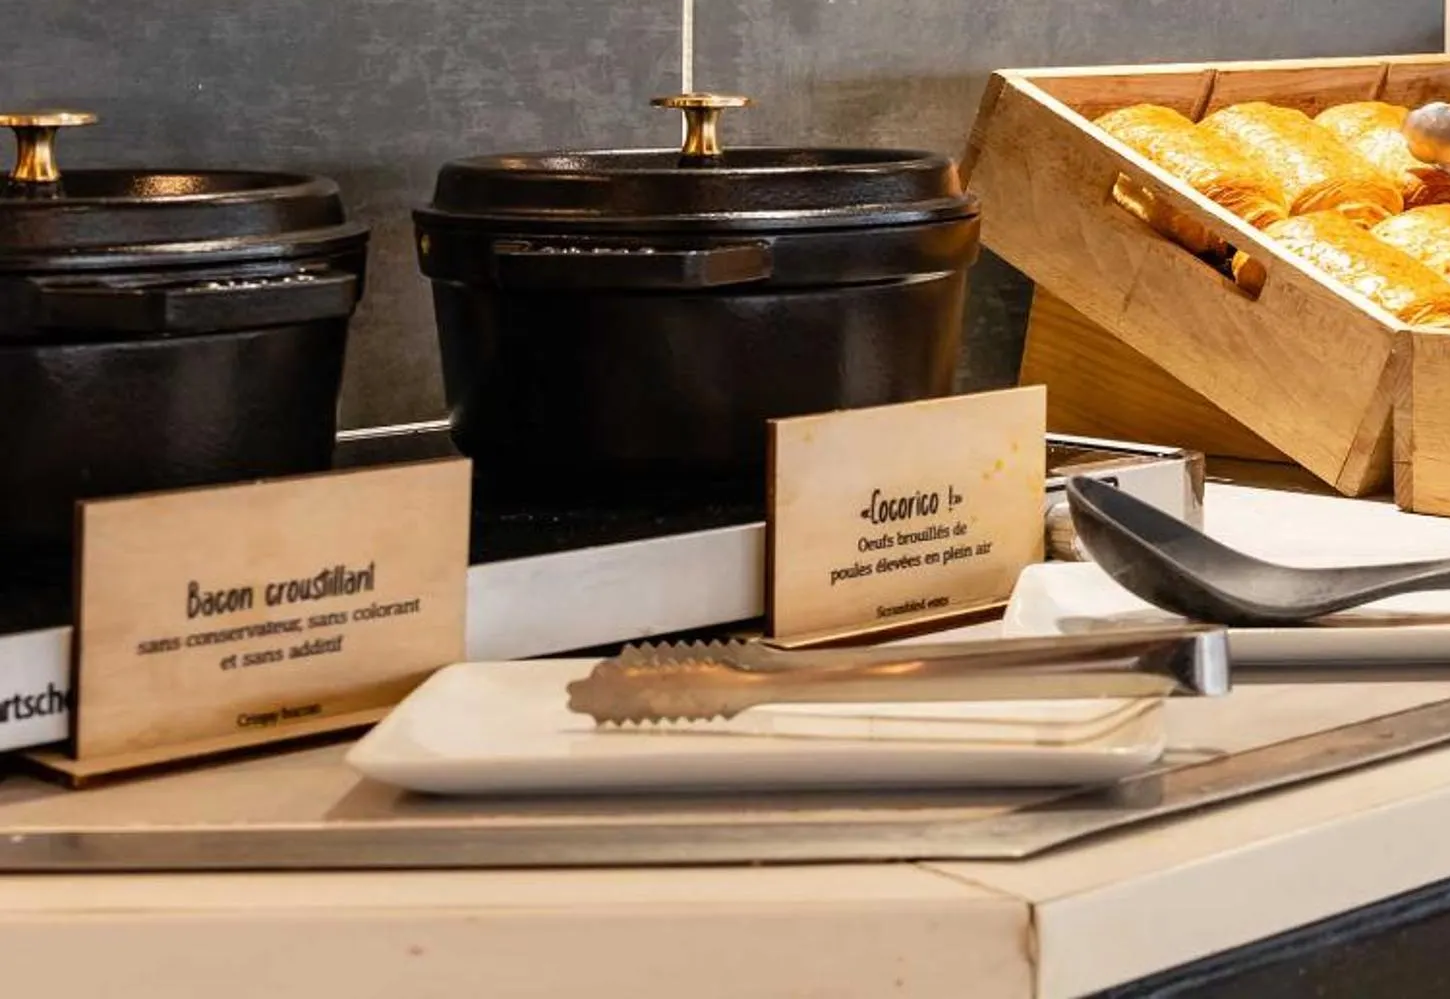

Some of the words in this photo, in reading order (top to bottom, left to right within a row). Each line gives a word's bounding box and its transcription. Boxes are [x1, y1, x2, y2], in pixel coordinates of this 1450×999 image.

[858, 534, 895, 552] Oeufs
[897, 525, 950, 546] brouillés
[953, 521, 968, 536] de
[830, 563, 873, 586] poules
[875, 554, 922, 574] élevées
[924, 552, 940, 565] en
[943, 545, 974, 565] plein
[975, 540, 993, 556] air
[187, 580, 253, 619] Bacon
[265, 561, 375, 607] croustillant
[137, 636, 181, 655] sans
[308, 611, 348, 628] sans
[352, 599, 421, 622] colorant
[220, 654, 237, 671] et
[243, 649, 284, 667] sans
[289, 635, 343, 660] additif
